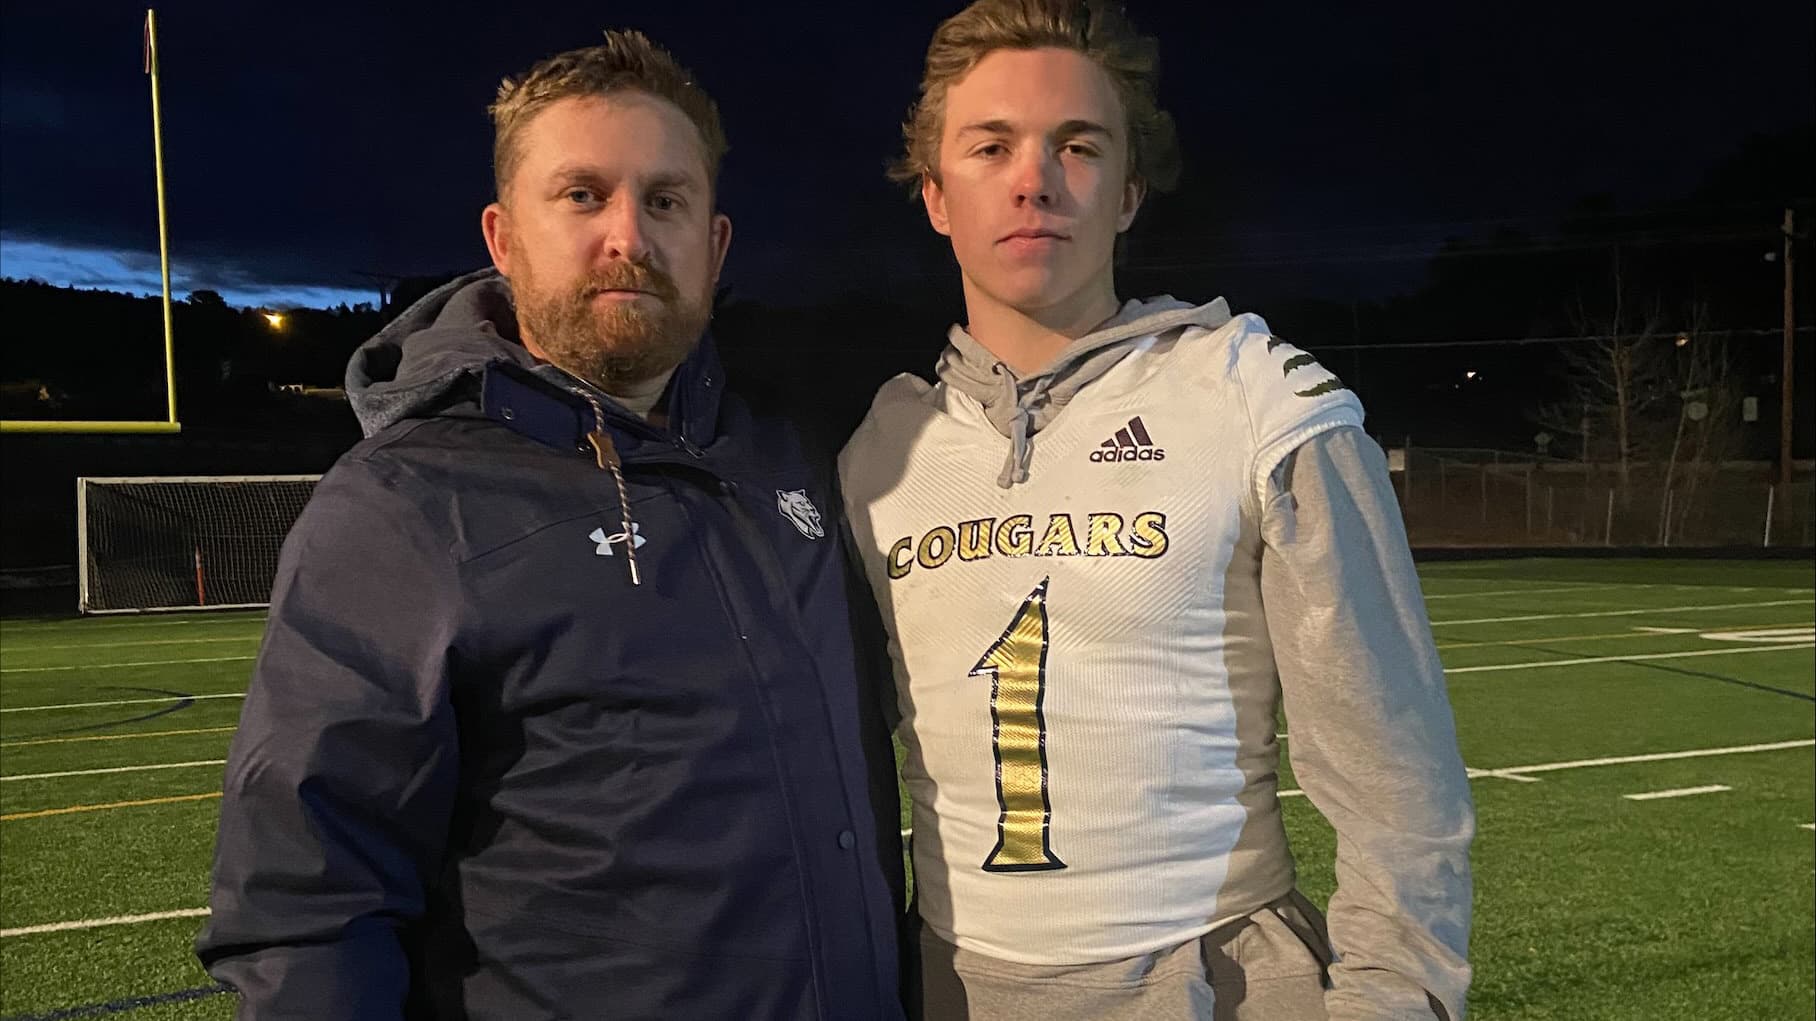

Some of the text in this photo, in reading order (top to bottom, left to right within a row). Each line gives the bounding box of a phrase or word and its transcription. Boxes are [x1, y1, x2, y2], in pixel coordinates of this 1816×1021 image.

[1089, 446, 1165, 462] adidas
[887, 511, 1169, 579] COUGARS
[968, 575, 1068, 872] 1
